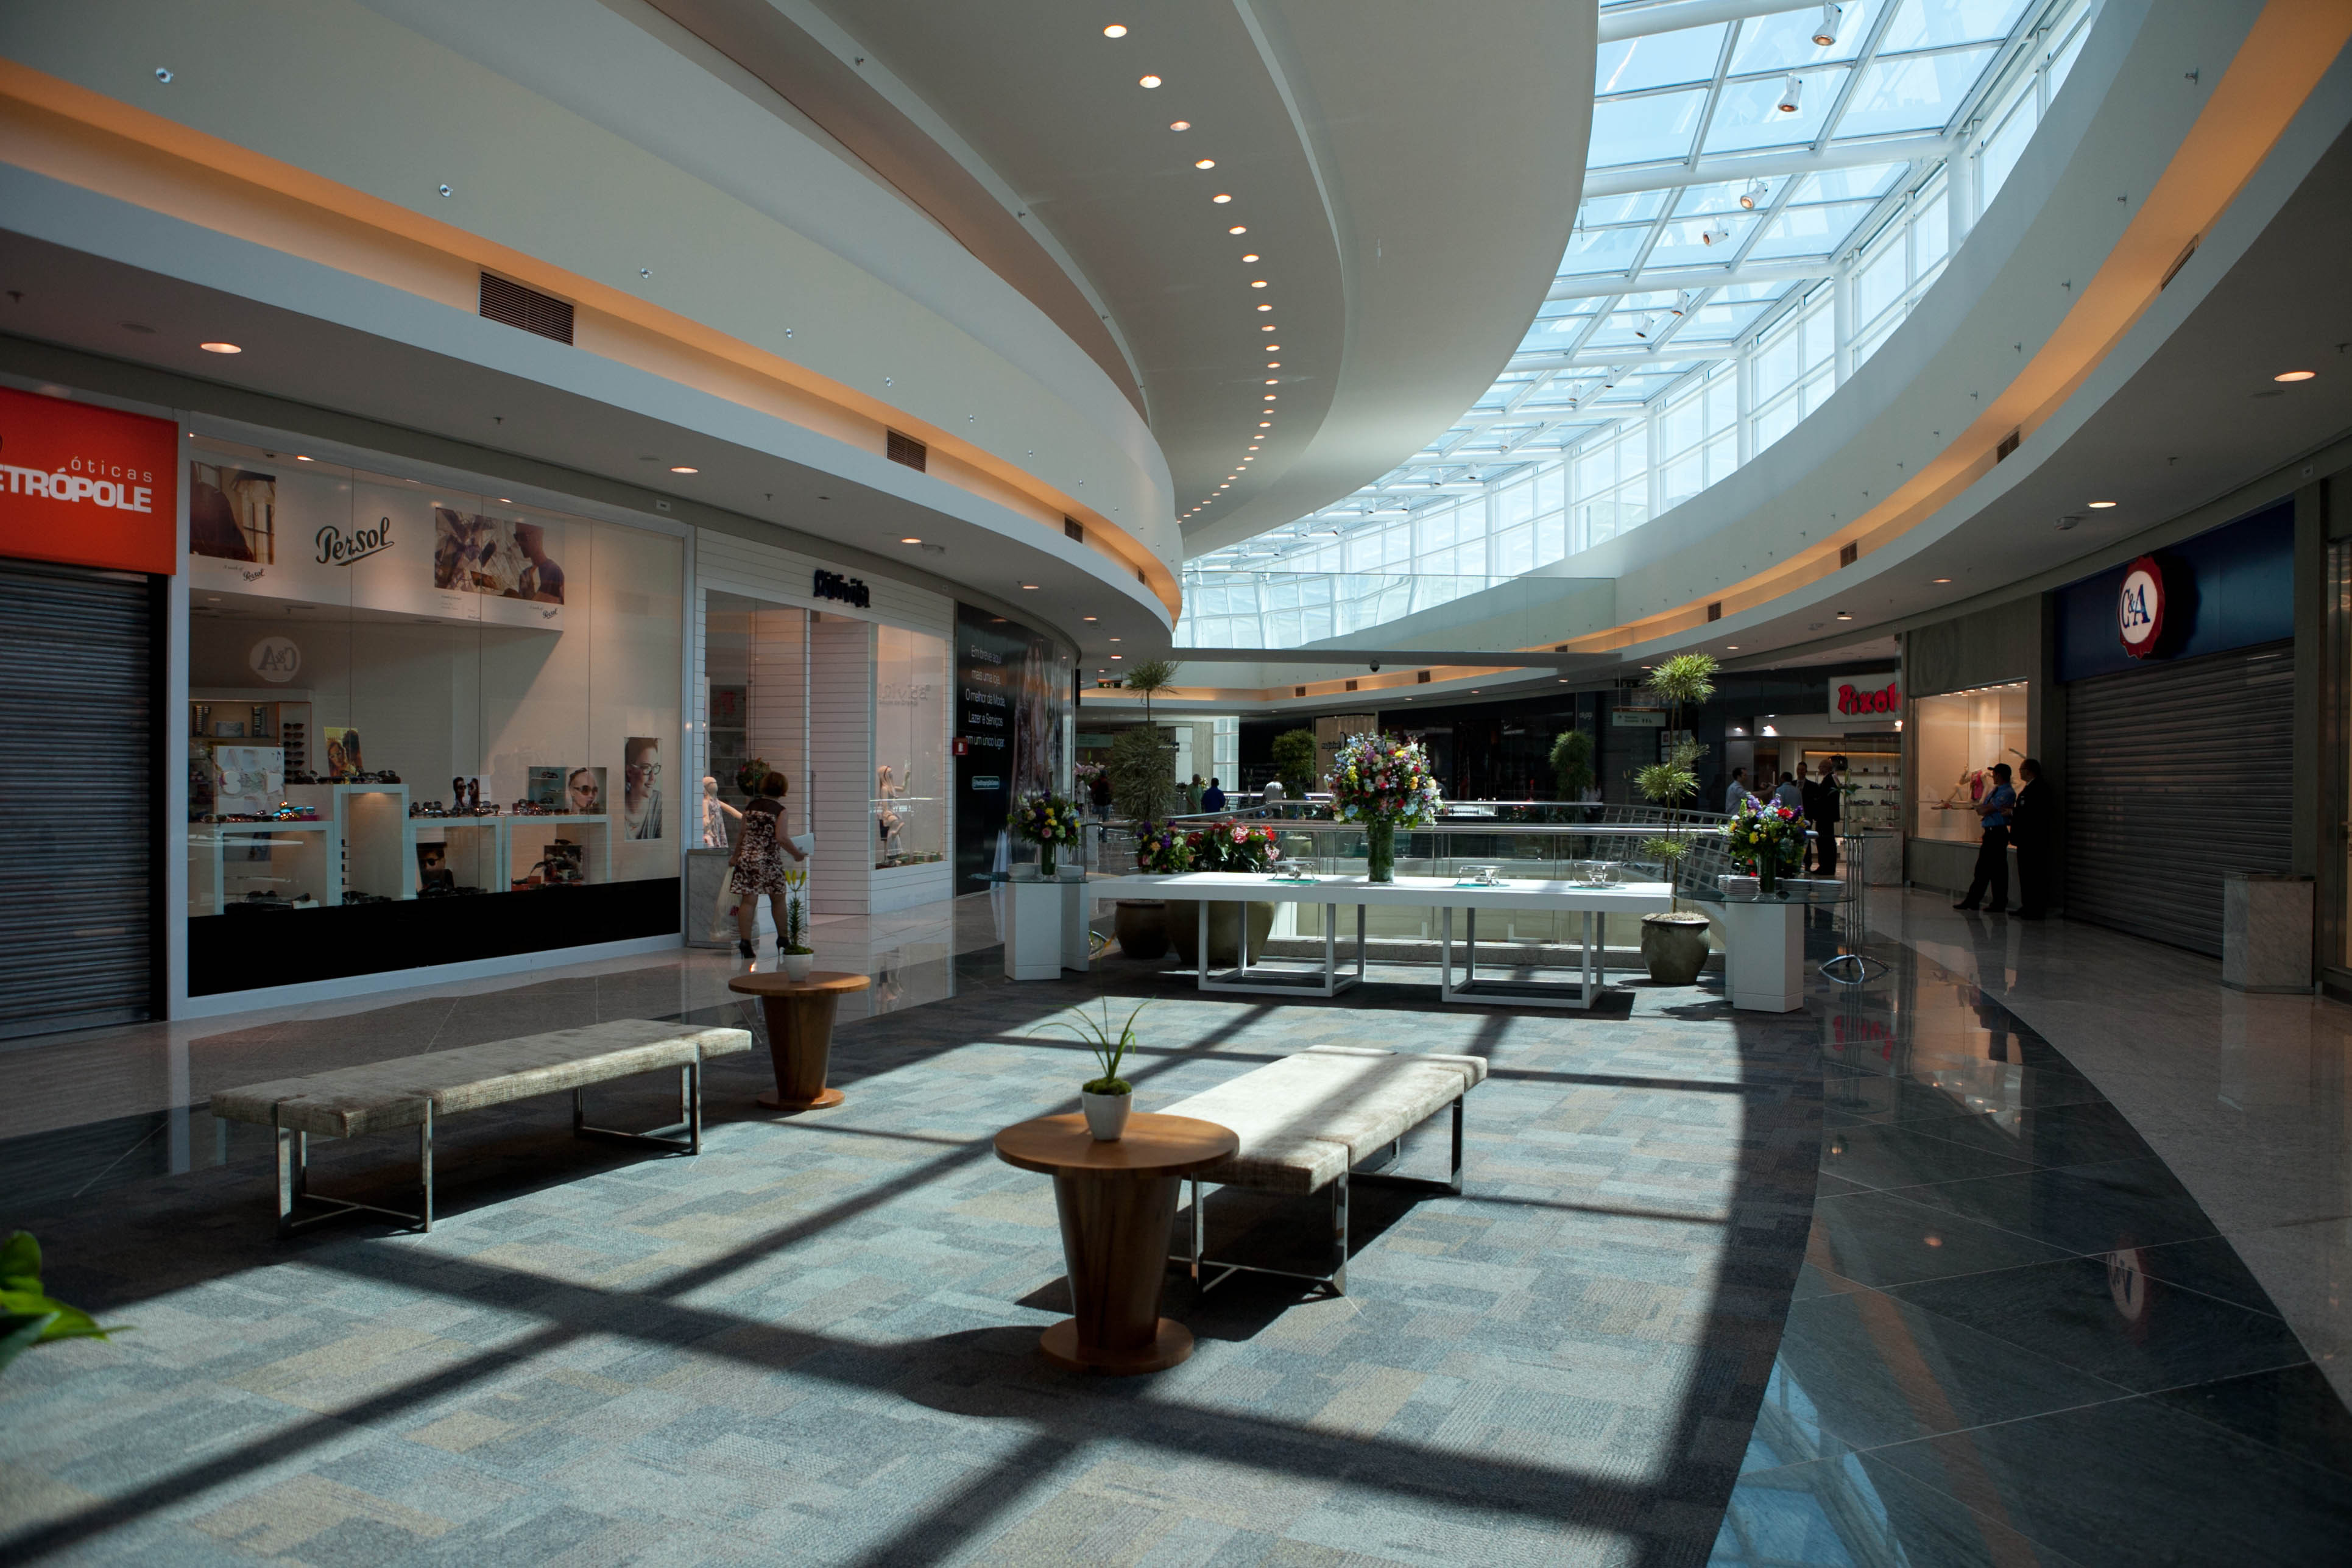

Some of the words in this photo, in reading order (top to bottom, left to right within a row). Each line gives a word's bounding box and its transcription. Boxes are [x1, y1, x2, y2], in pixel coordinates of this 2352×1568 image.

[71, 456, 152, 482] óticas
[0, 464, 152, 513] TRÓPOLE
[316, 517, 395, 566] Persol
[2121, 584, 2150, 629] C&A
[971, 645, 979, 657] Em
[966, 688, 970, 701] O
[970, 691, 986, 702] melhor
[968, 711, 981, 724] Lazer
[982, 715, 986, 724] e
[986, 713, 1003, 729] Serviços
[974, 736, 982, 745] um
